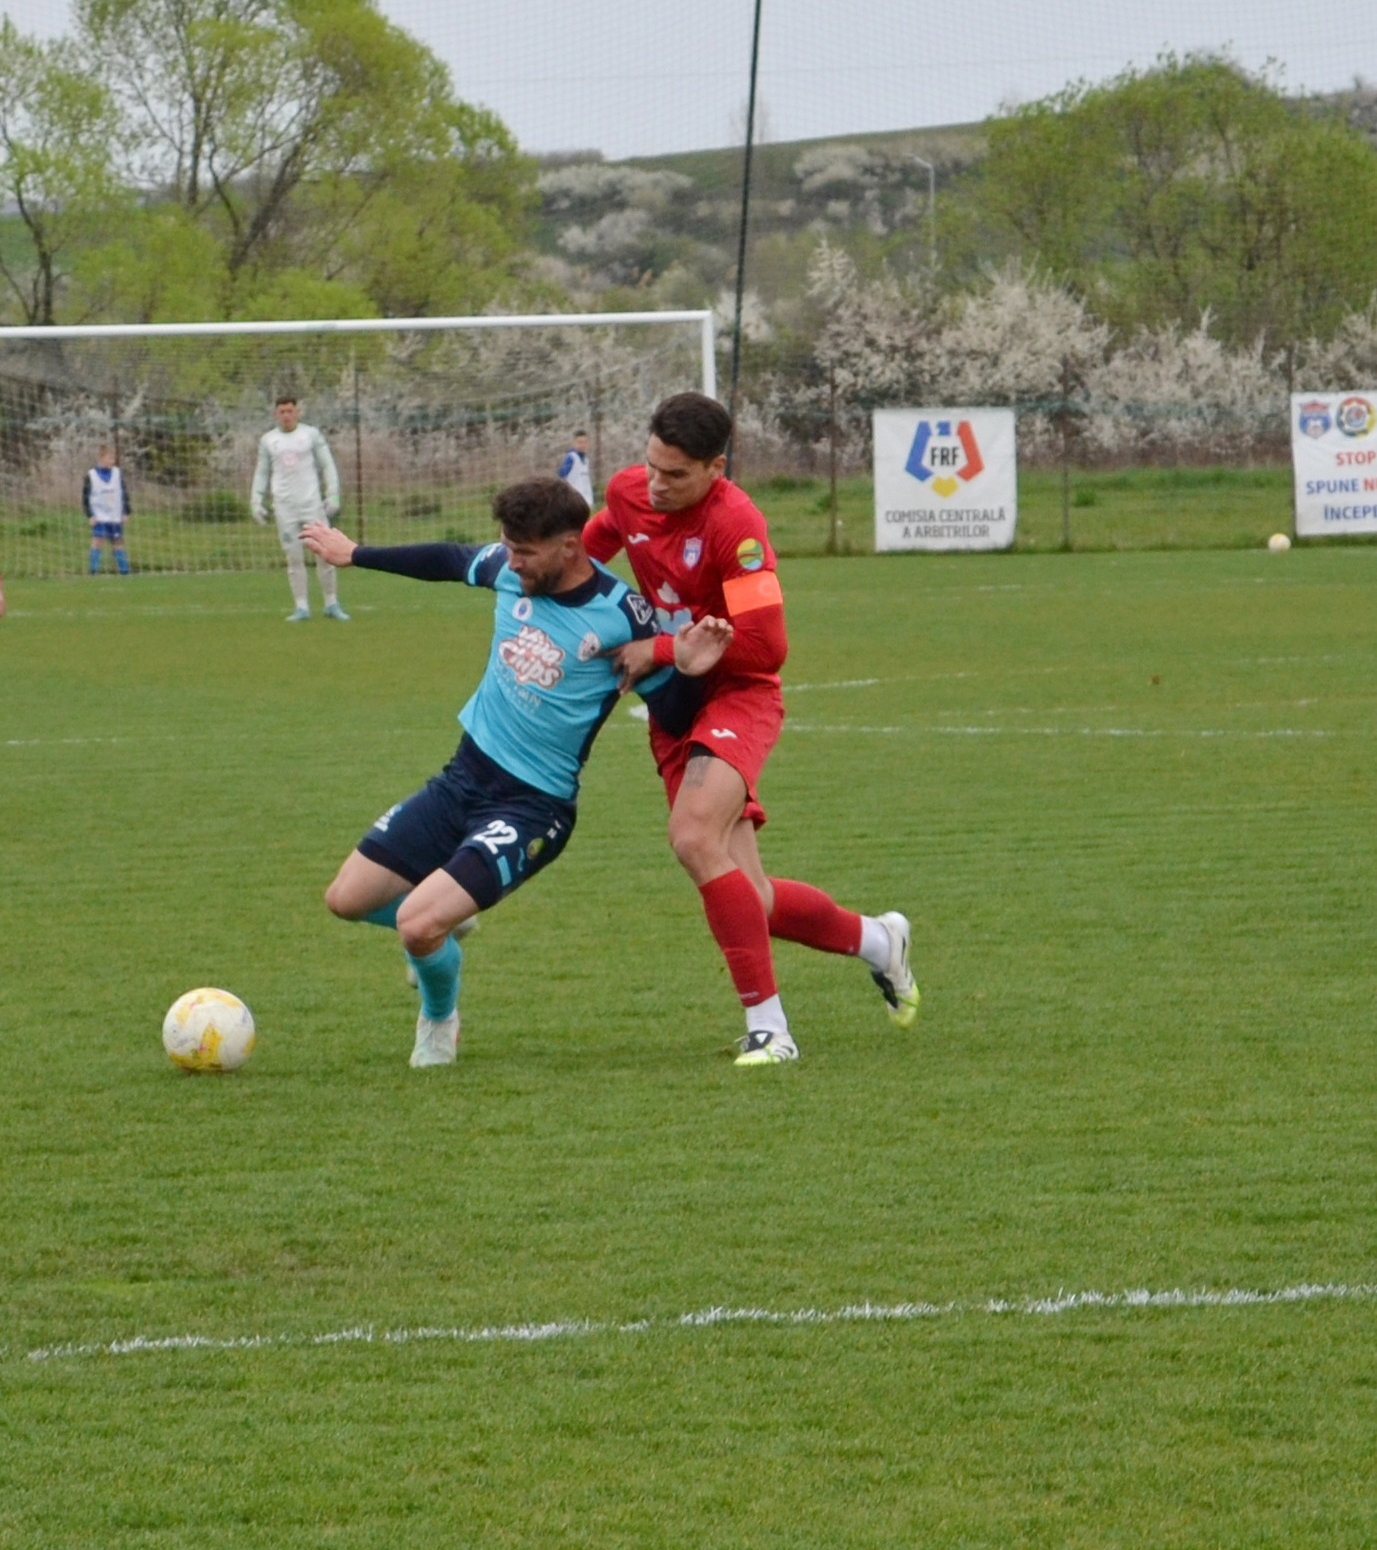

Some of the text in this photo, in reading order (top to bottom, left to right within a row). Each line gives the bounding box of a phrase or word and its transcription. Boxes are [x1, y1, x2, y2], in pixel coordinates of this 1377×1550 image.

[930, 446, 959, 467] FRF
[1336, 451, 1376, 467] STOP
[1306, 477, 1377, 496] SPUNE N
[885, 509, 936, 523] COMISIA
[903, 524, 990, 539] A ARBITRILOR
[473, 819, 518, 855] 22
